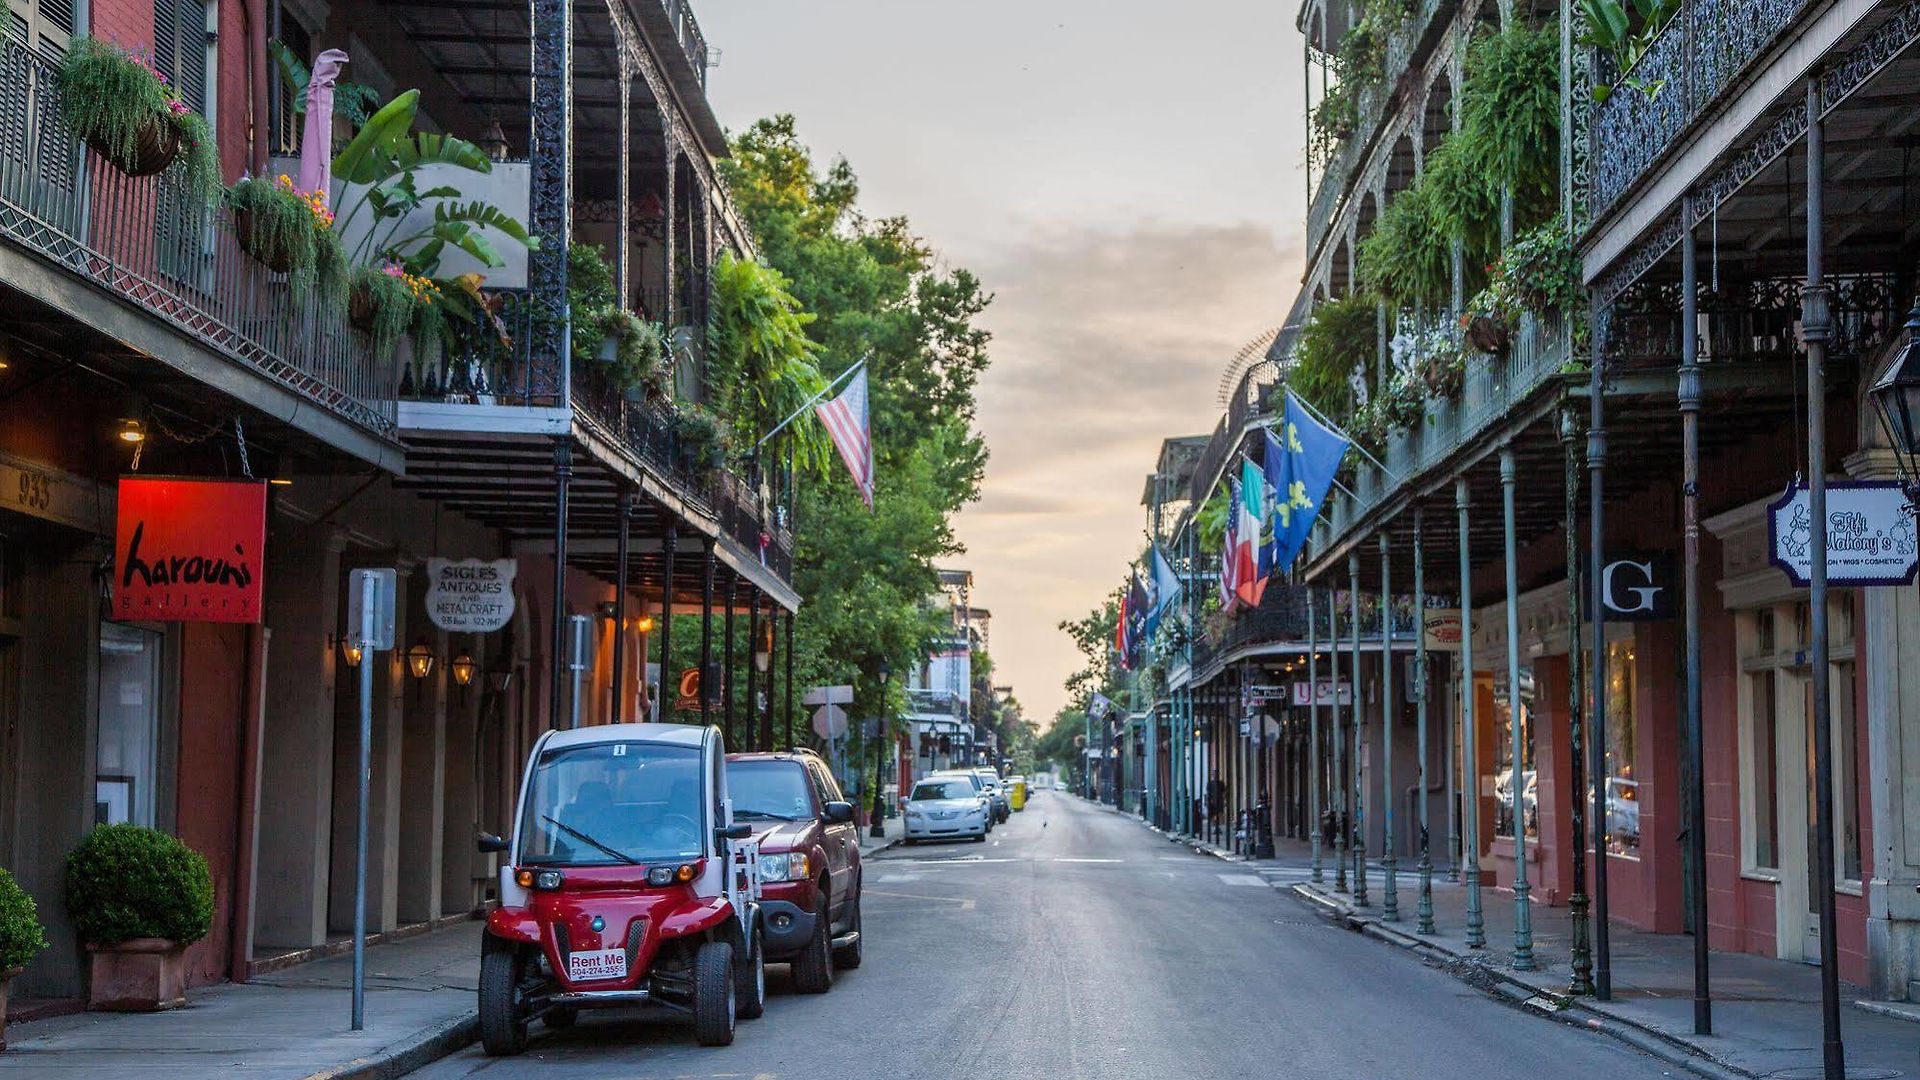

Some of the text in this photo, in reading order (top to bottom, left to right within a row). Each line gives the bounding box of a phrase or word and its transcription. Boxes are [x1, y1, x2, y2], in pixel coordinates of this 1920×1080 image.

[123, 520, 252, 588] harouni
[438, 581, 502, 593] ANTIQUES
[1602, 560, 1663, 612] G
[122, 593, 250, 609] gallery
[436, 603, 503, 614] METALCRAFT
[571, 954, 624, 967] Rent Me
